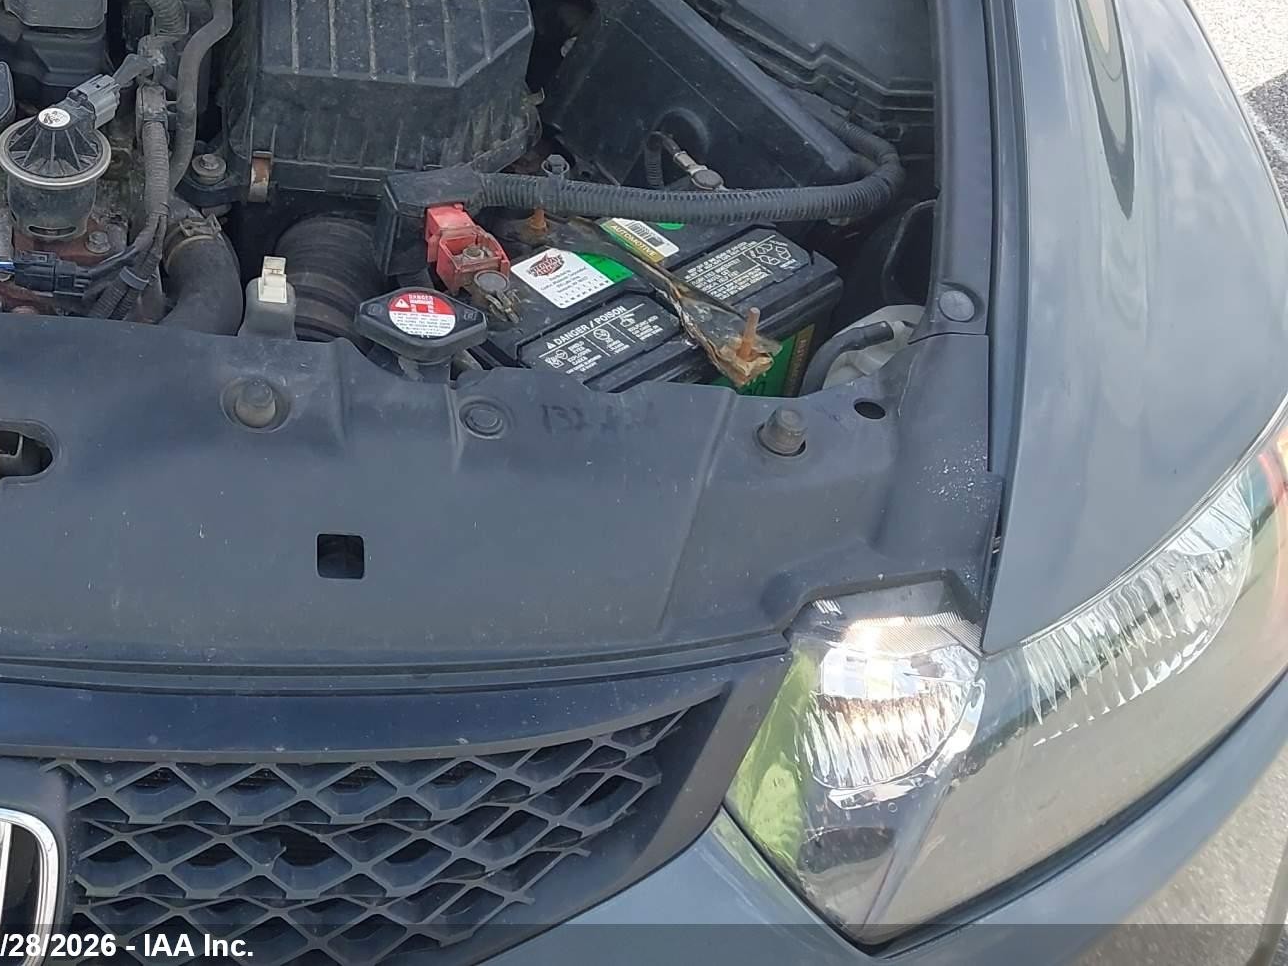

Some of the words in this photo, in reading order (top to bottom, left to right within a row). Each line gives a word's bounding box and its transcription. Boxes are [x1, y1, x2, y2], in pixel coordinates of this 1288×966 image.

[611, 224, 657, 256] AUTOMOTIVE
[554, 323, 590, 346] DANGER
[594, 305, 627, 325] POISON
